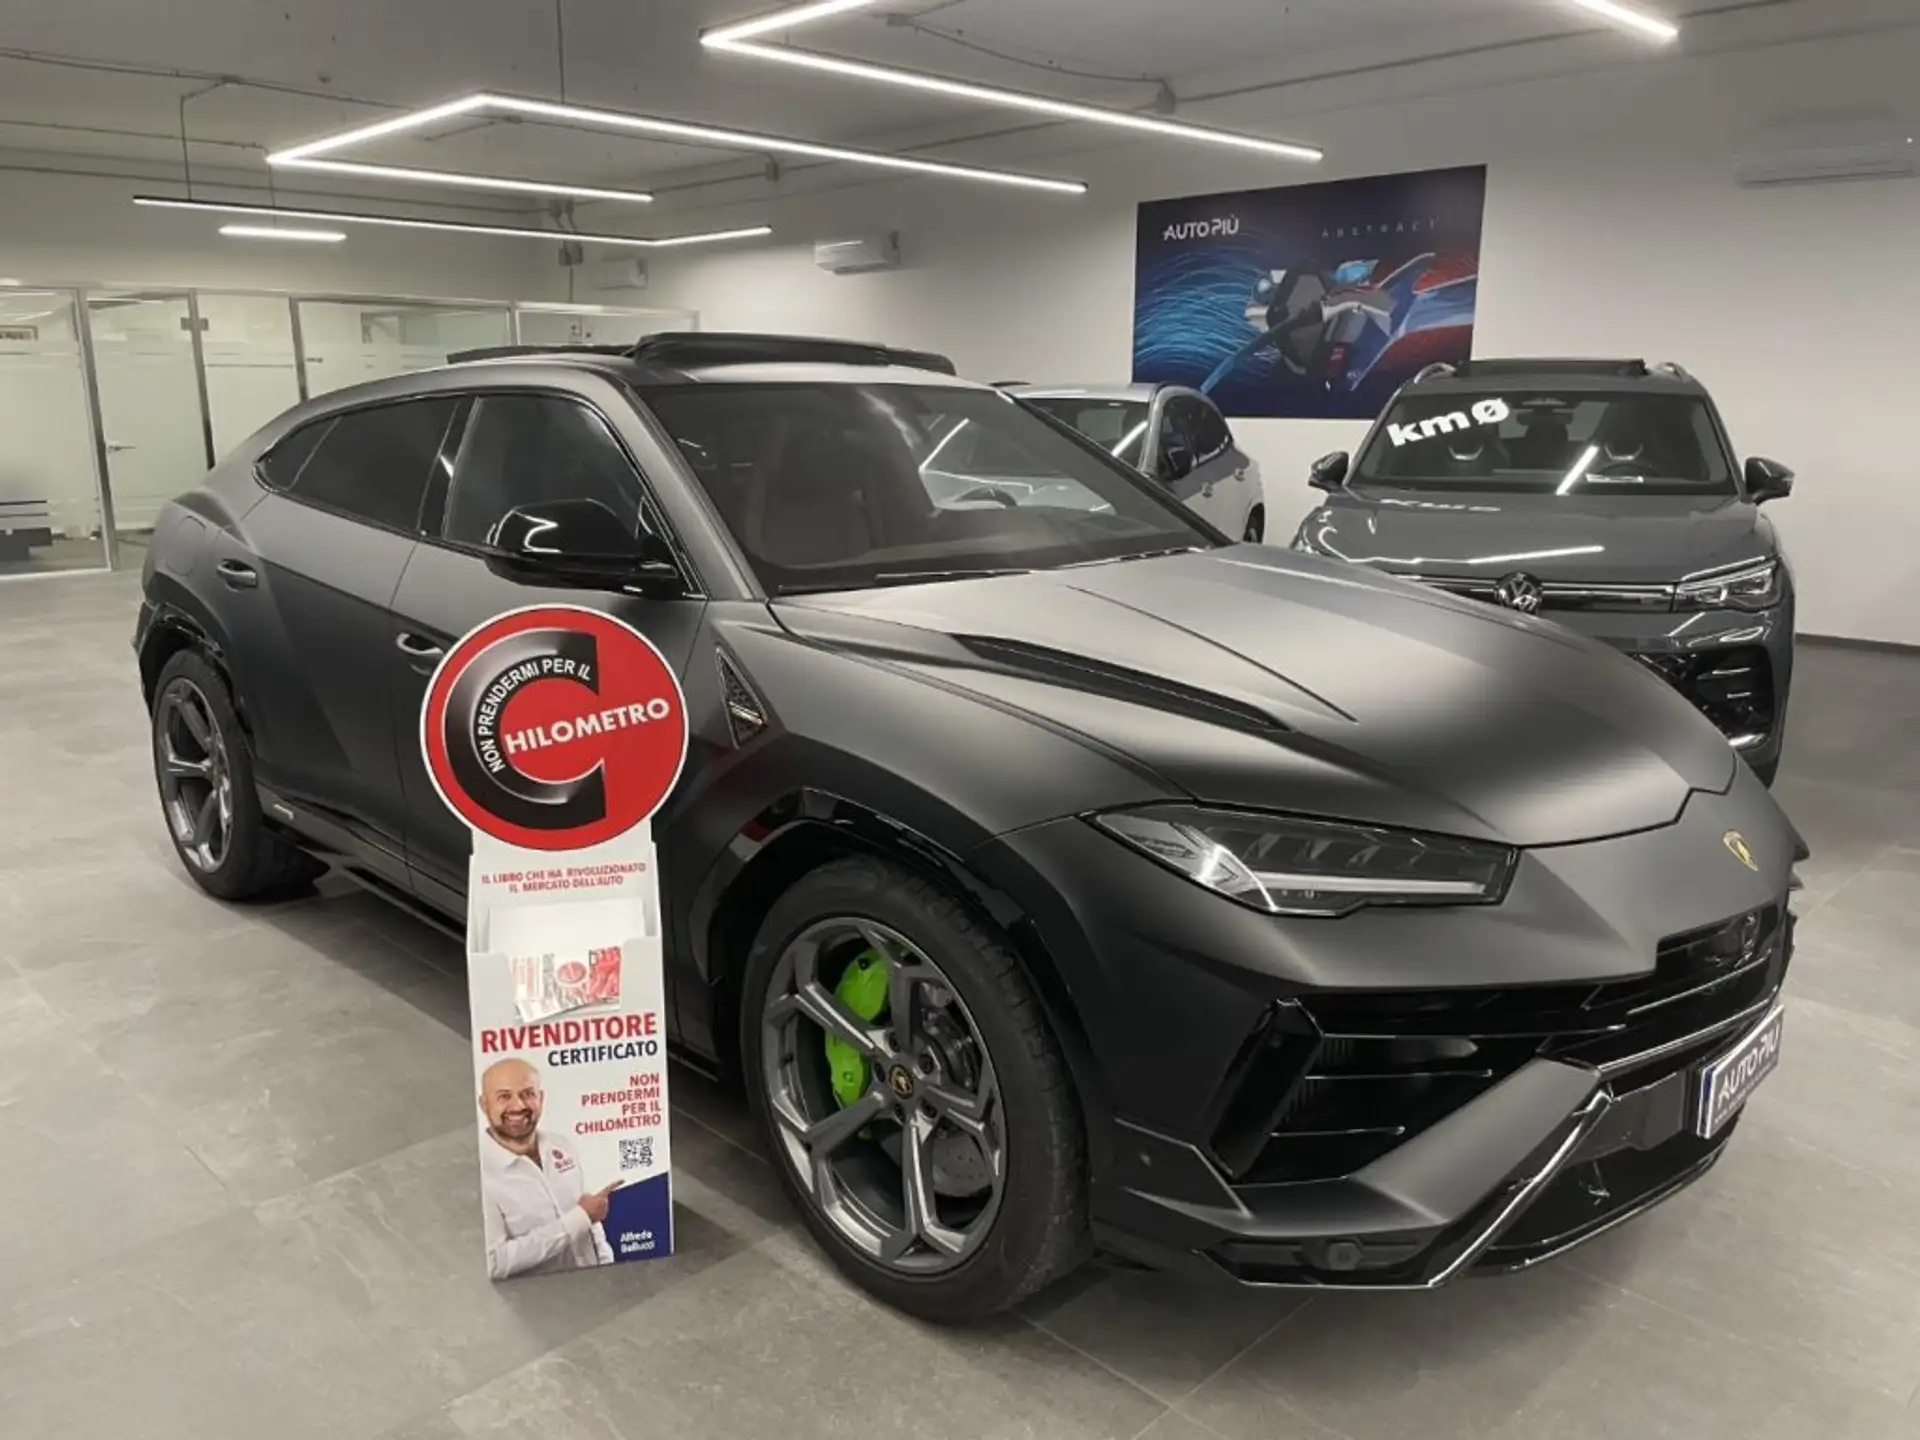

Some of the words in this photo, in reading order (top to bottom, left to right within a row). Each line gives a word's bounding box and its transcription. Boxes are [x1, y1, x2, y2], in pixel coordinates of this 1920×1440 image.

[1386, 411, 1471, 447] km
[541, 658, 576, 675] PER
[577, 663, 592, 681] IL
[477, 661, 540, 736] PRENDERMI
[479, 738, 506, 773] NON
[481, 874, 492, 884] IL
[493, 871, 524, 883] LIBRO
[525, 869, 546, 881] CHE
[547, 867, 563, 879] HA
[566, 862, 647, 876] RIVOLUZIONATO
[509, 884, 518, 894] IL
[522, 878, 570, 892] MERCATO
[572, 874, 624, 888] DELL'AUTO
[481, 1012, 658, 1053] RIVENDITORE
[547, 1040, 658, 1067] CERTIFICATO
[629, 1072, 660, 1086] NON
[581, 1086, 660, 1106] PRENDERMI
[622, 1102, 647, 1115] PER
[650, 1100, 662, 1112] IL
[575, 1113, 662, 1135] CHILOMETRO
